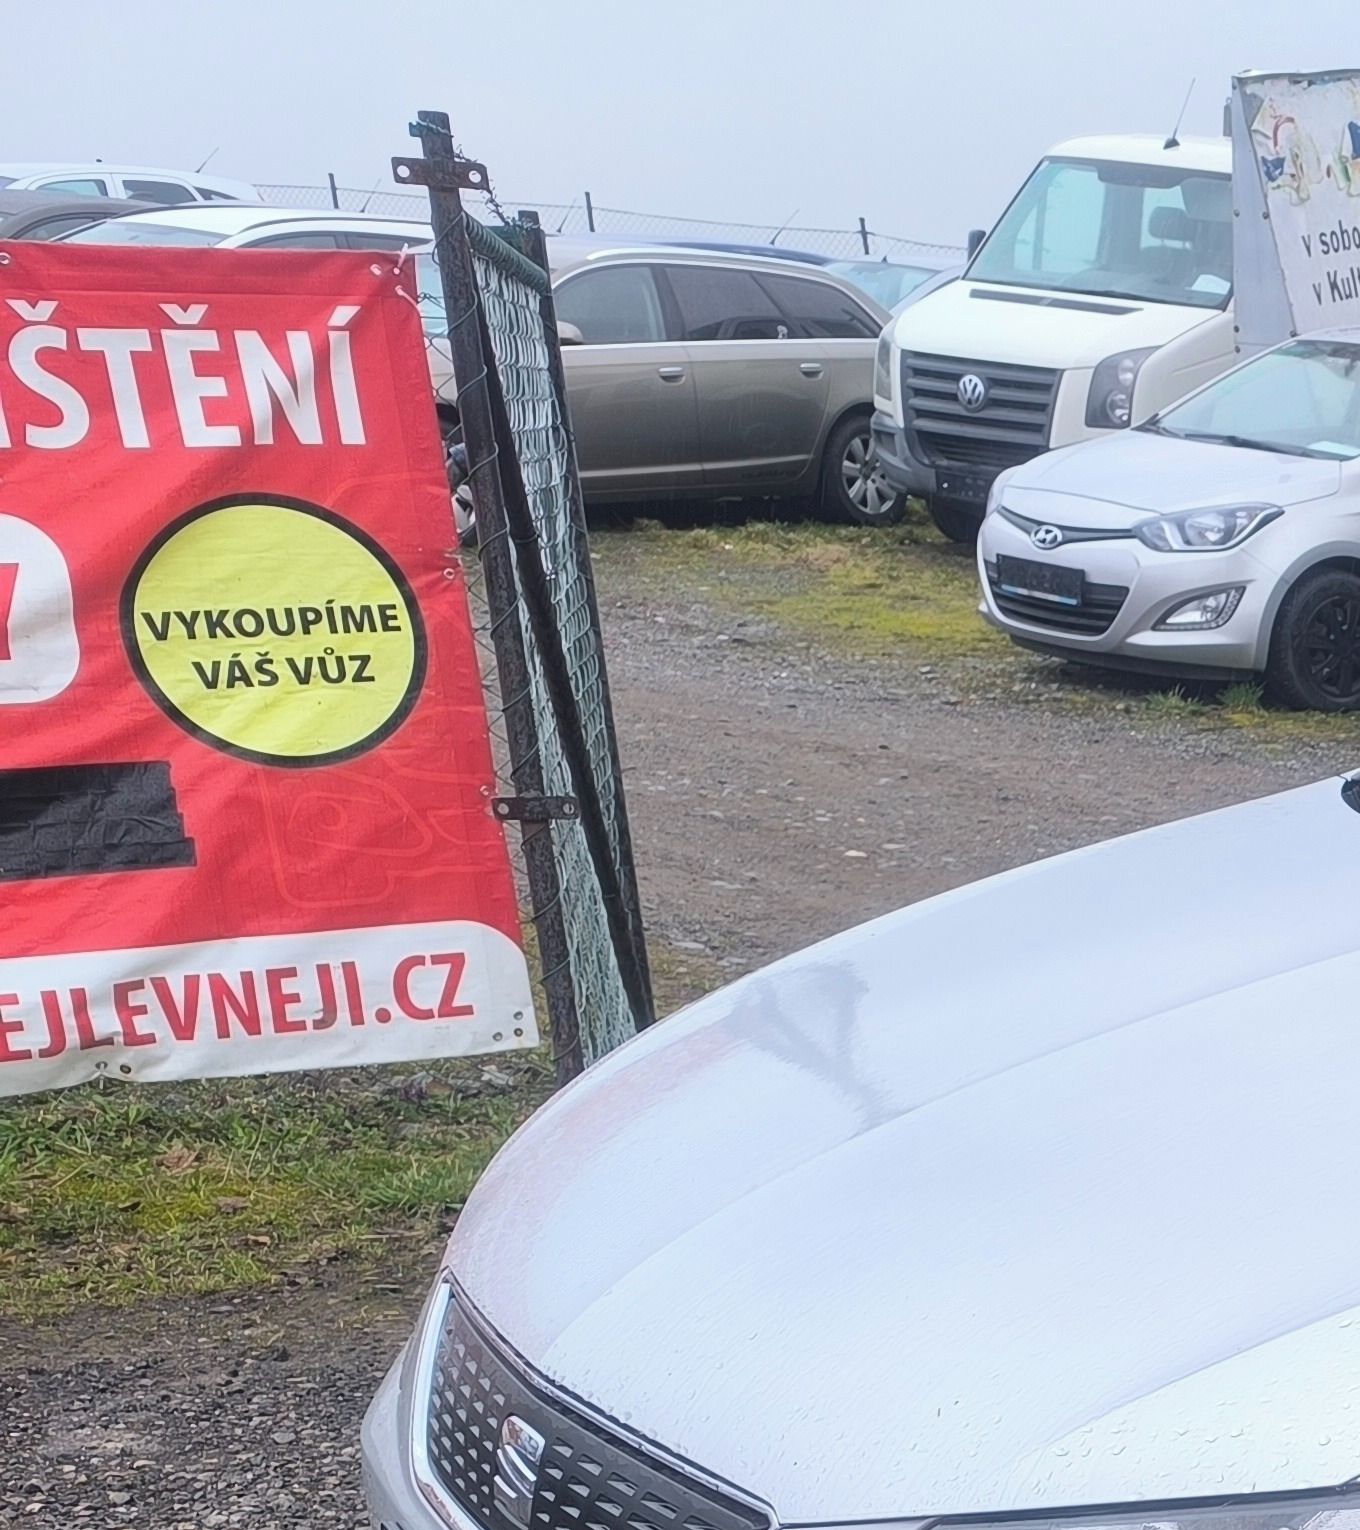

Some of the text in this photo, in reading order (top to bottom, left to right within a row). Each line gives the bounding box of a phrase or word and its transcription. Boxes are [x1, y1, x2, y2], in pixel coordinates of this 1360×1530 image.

[1301, 233, 1312, 258] v
[1311, 281, 1323, 306] v
[0, 299, 367, 449] ŠTĚNÍ
[141, 599, 402, 642] VYKOUPÍME
[191, 646, 376, 691] VÁŠ VŮZ
